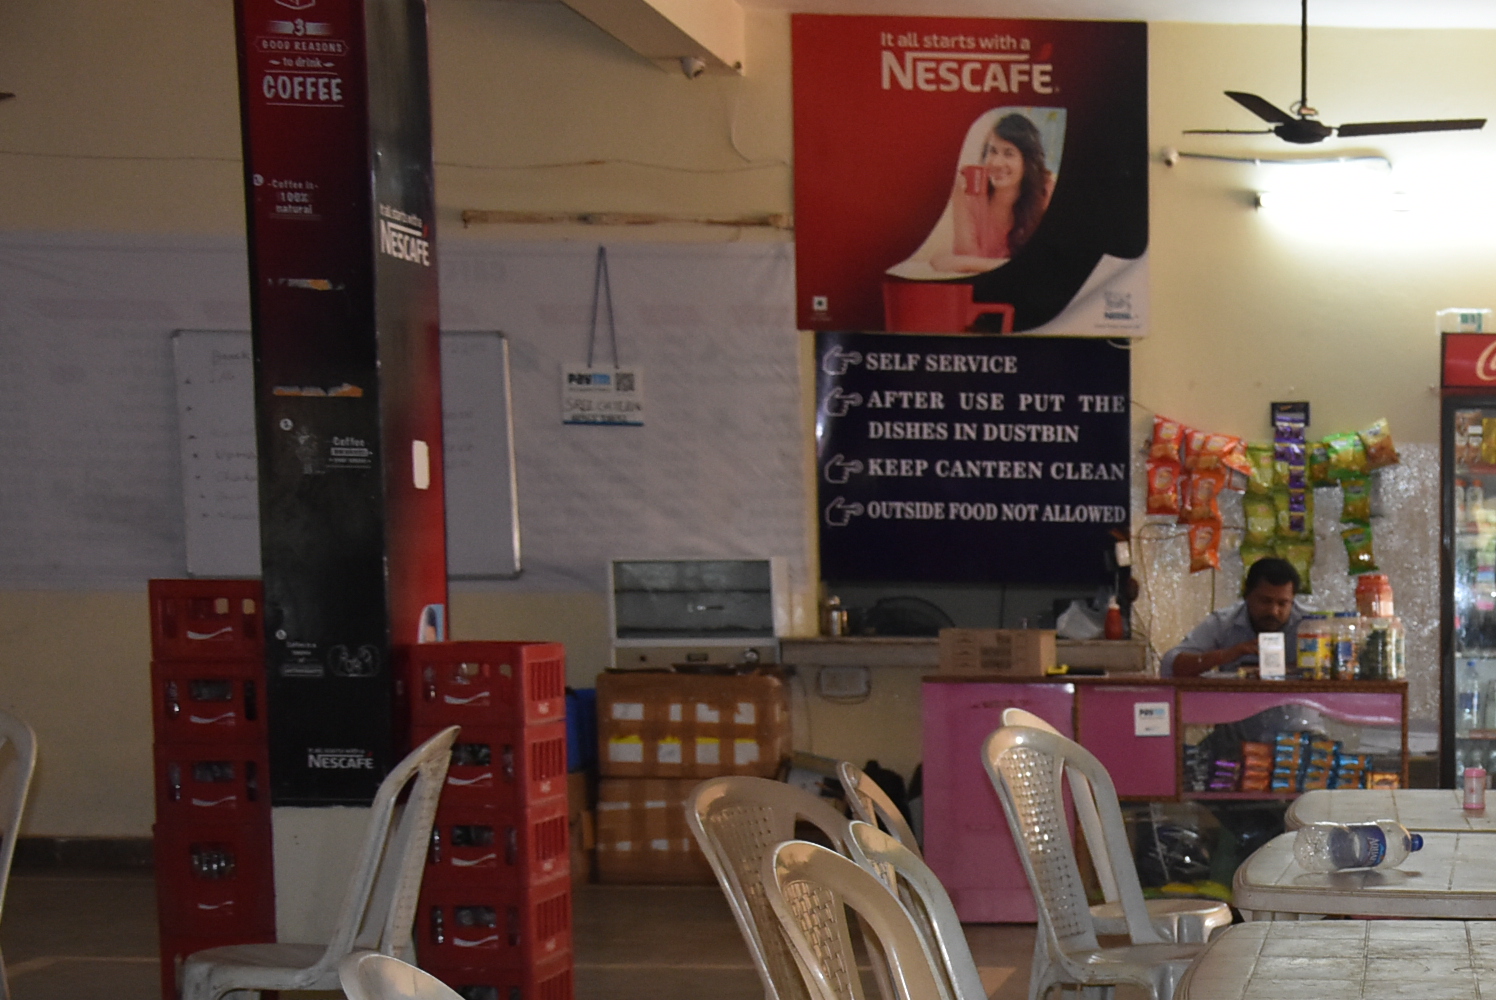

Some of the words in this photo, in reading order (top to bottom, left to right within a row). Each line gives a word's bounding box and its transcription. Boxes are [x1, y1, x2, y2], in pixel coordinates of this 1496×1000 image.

[293, 18, 306, 37] 3
[261, 39, 291, 51] GOOD
[294, 40, 344, 53] REASONS
[881, 31, 895, 47] It
[897, 31, 919, 48] all
[922, 33, 976, 50] starts
[978, 34, 1017, 50] with
[1020, 37, 1031, 51] a
[282, 56, 293, 67] to
[295, 56, 323, 68] drink
[262, 74, 343, 102] COFFEE
[866, 352, 920, 371] SELF
[925, 353, 1017, 374] SERVICE
[867, 390, 945, 410] AFTER
[959, 391, 1005, 411] USE
[1018, 393, 1065, 412] PUT
[1078, 394, 1126, 413] THE
[868, 421, 948, 440] DISHES
[954, 422, 977, 441] IN
[982, 424, 1080, 443] DUSTBIN
[867, 458, 929, 477] KEEP
[934, 459, 1044, 480] CANTEEN
[1050, 461, 1126, 481] CLEAN
[867, 500, 945, 520] OUTSIDE
[949, 502, 998, 521] FOOD
[1001, 503, 1040, 522] NOT
[1042, 504, 1126, 523] ALLOWED
